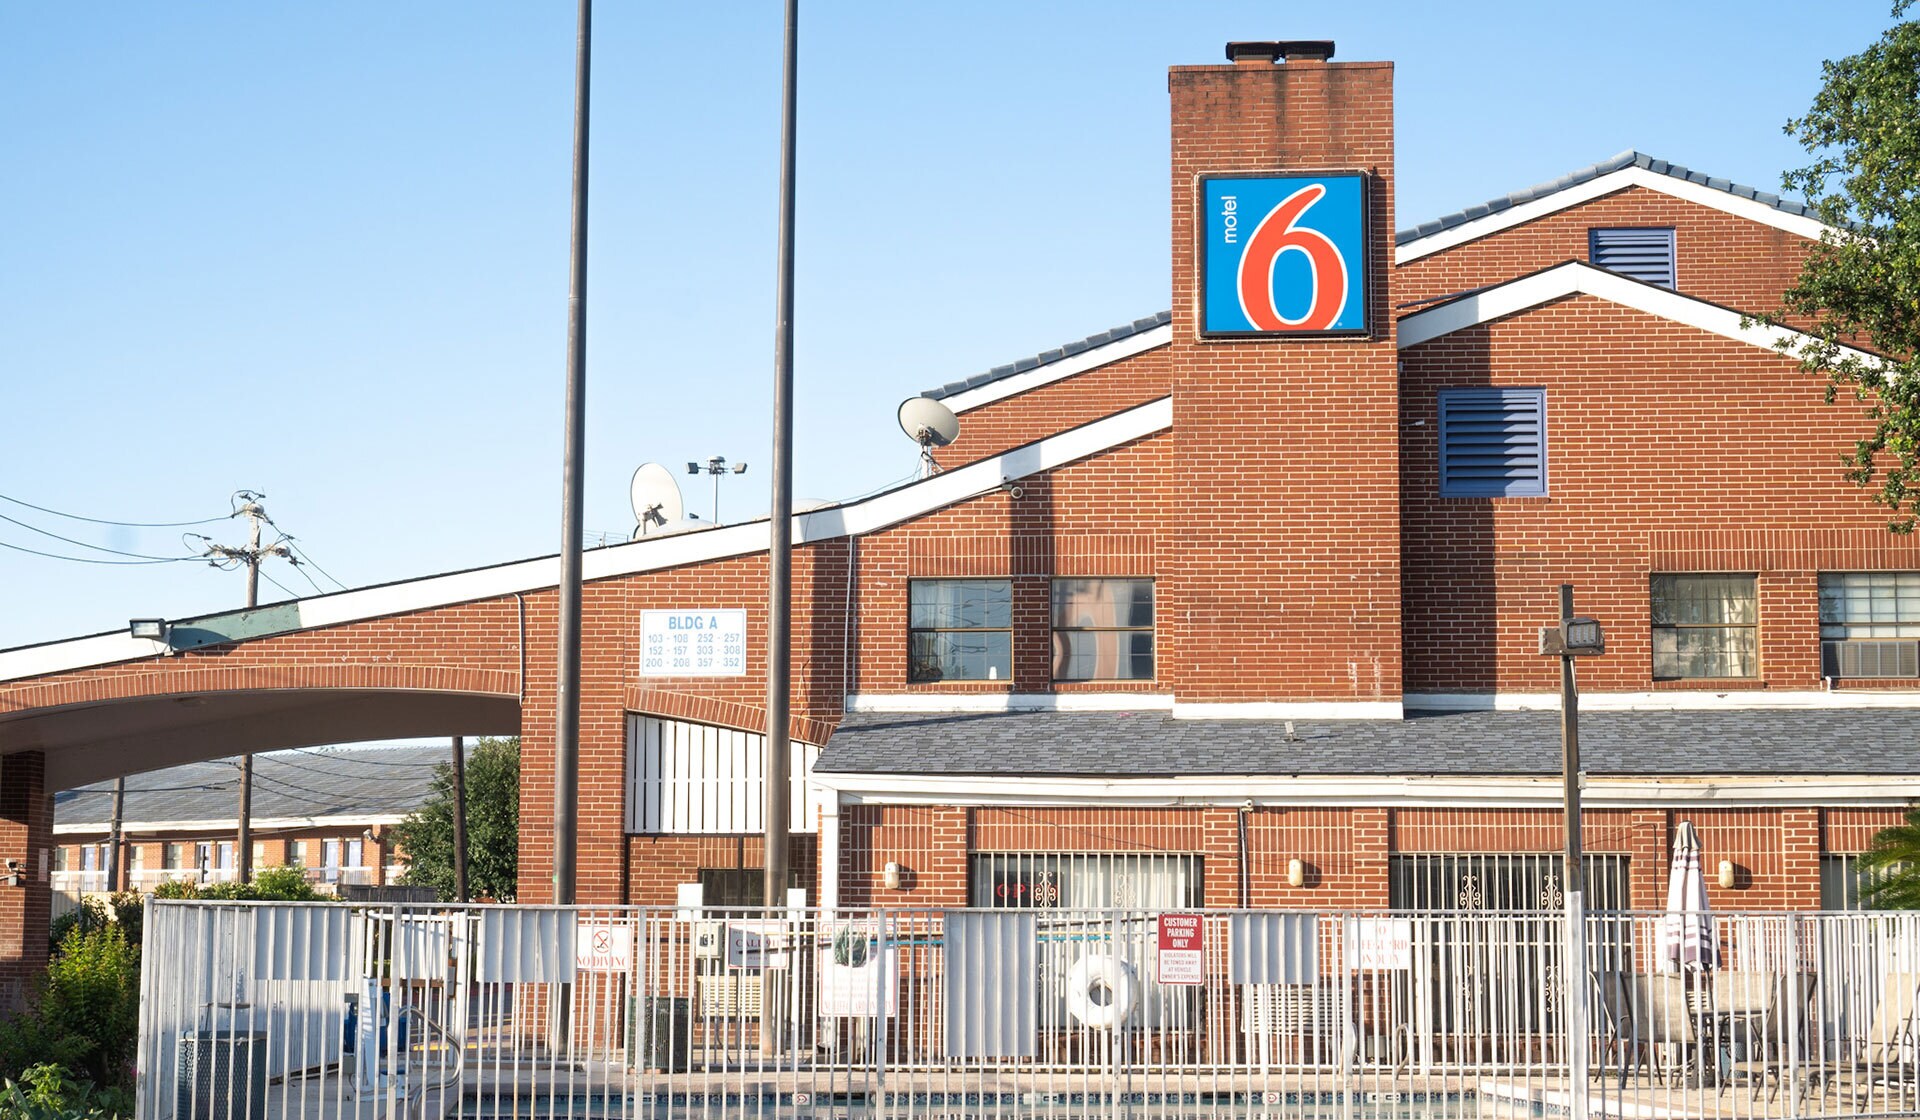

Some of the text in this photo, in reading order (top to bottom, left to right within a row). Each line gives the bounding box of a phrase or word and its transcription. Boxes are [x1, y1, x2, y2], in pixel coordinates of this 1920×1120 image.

[1221, 196, 1237, 244] motel
[1236, 183, 1349, 331] 6
[668, 616, 718, 630] BLDG A
[648, 634, 663, 643] 103
[673, 633, 689, 643] 108
[697, 633, 714, 643] 252
[724, 633, 740, 642] 257
[649, 646, 663, 655] 152
[673, 646, 688, 655] 157
[696, 646, 713, 655] 303
[723, 645, 741, 655] 308
[646, 658, 663, 668] 200
[673, 658, 690, 667] 208
[697, 658, 713, 667] 357
[723, 657, 740, 667] 352
[1163, 917, 1198, 927] CUSTOMER
[1166, 928, 1195, 938] PARKING
[1172, 938, 1189, 948] ONLY
